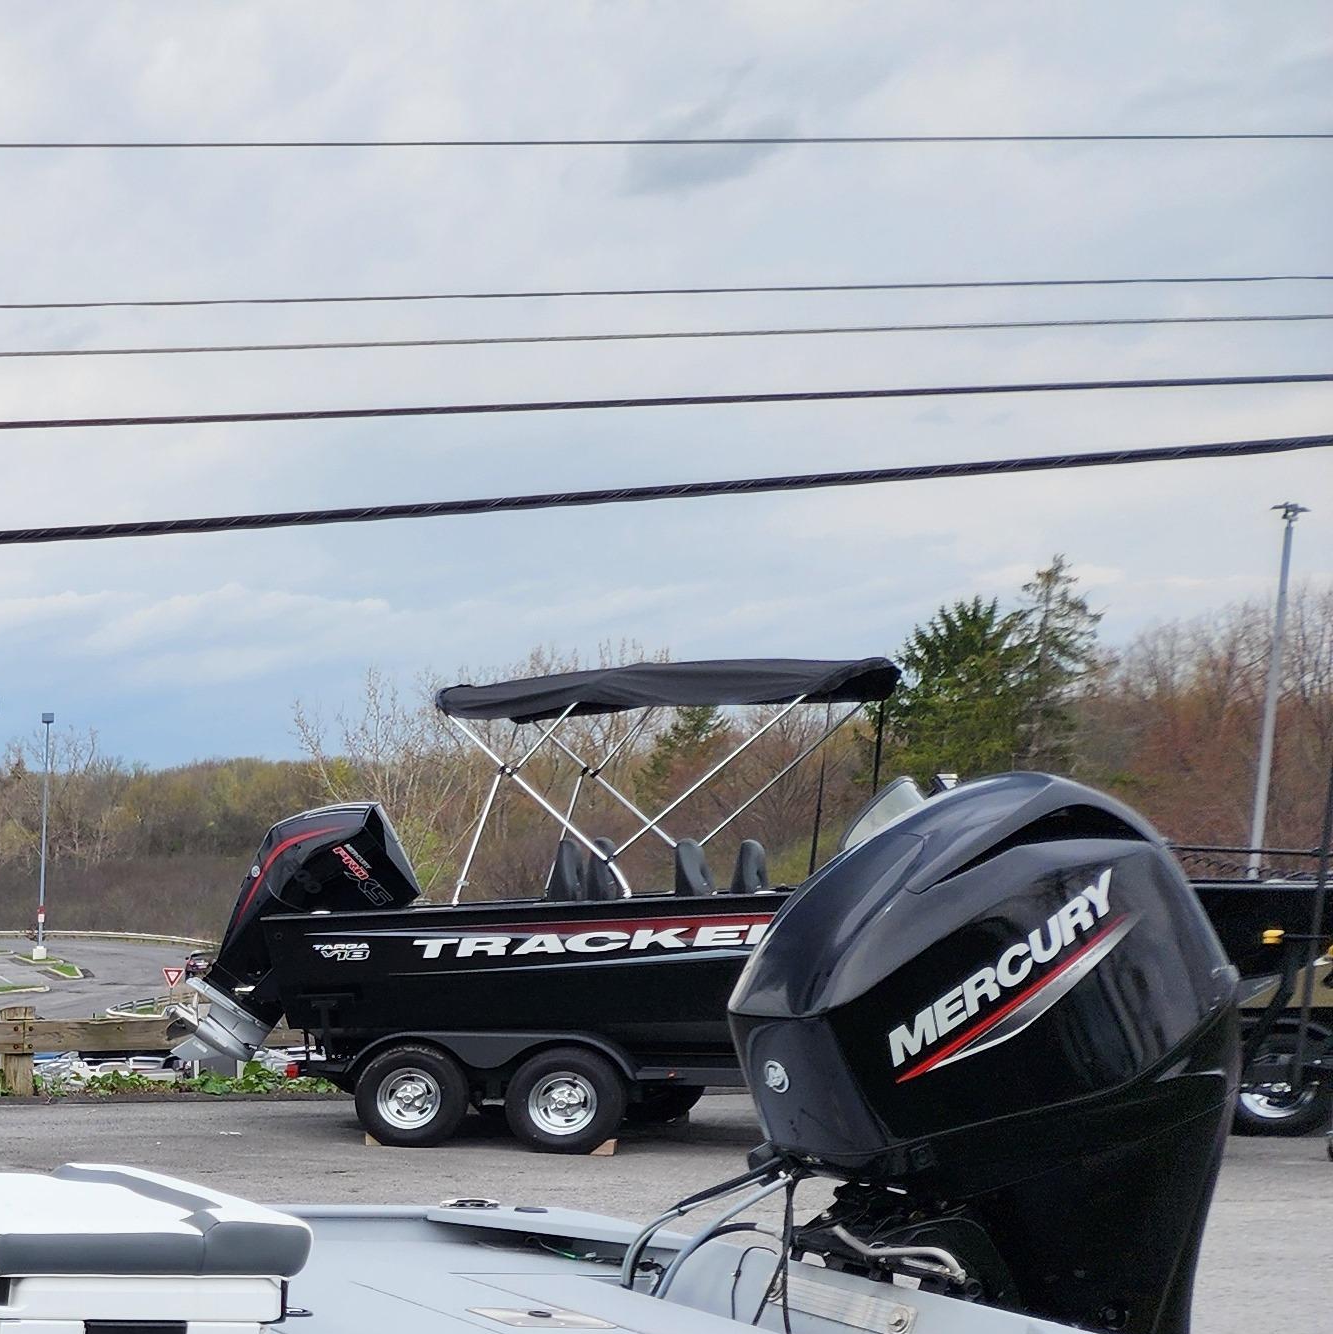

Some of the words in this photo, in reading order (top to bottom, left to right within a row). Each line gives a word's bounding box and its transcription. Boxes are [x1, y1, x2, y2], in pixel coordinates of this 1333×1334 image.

[332, 846, 370, 881] PRO
[343, 870, 394, 906] XS
[321, 949, 371, 962] V18
[888, 868, 1113, 1068] MERCURY
